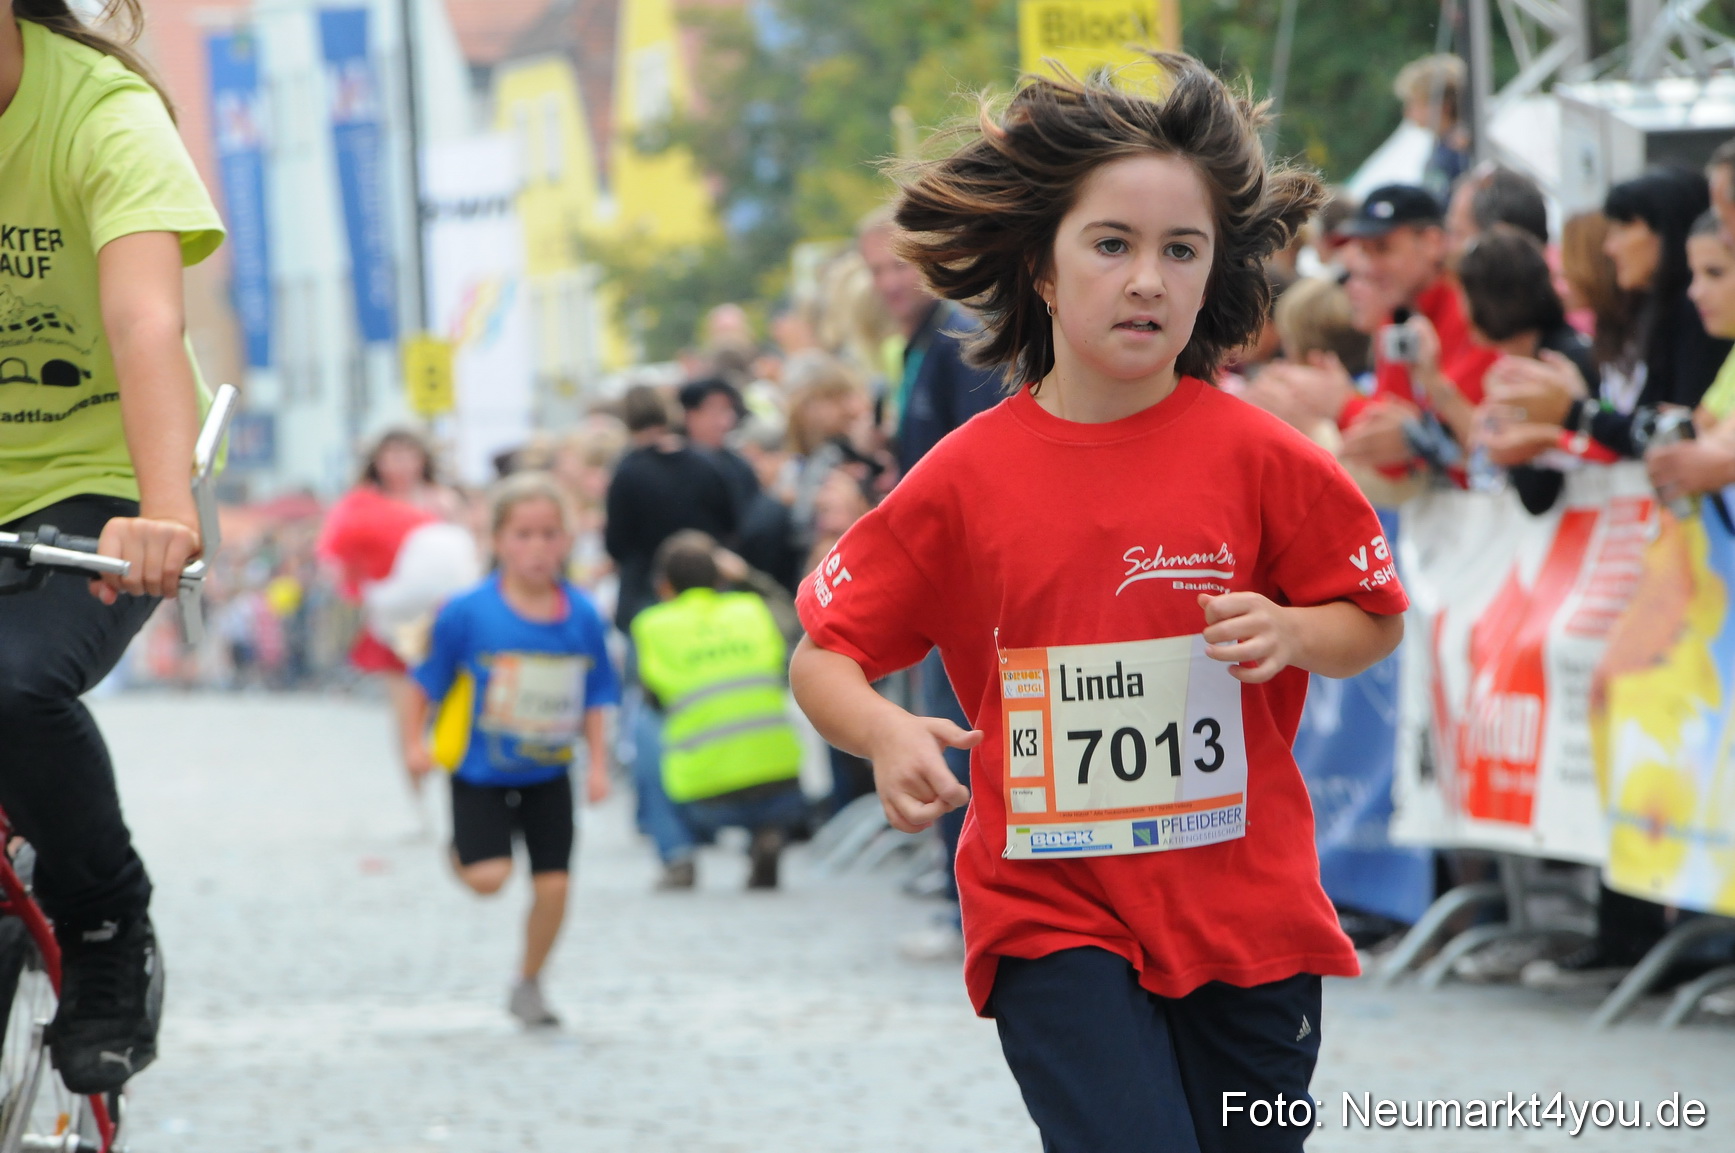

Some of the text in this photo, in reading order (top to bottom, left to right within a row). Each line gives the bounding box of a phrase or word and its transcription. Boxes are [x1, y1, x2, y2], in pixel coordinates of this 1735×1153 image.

[0, 224, 64, 252] KTER
[0, 254, 52, 279] AUF
[1060, 661, 1144, 702] Linda
[1012, 729, 1037, 757] K3
[1067, 717, 1225, 785] 7013
[1161, 807, 1242, 834] PFLEIDERER
[1031, 830, 1094, 847] BOCK
